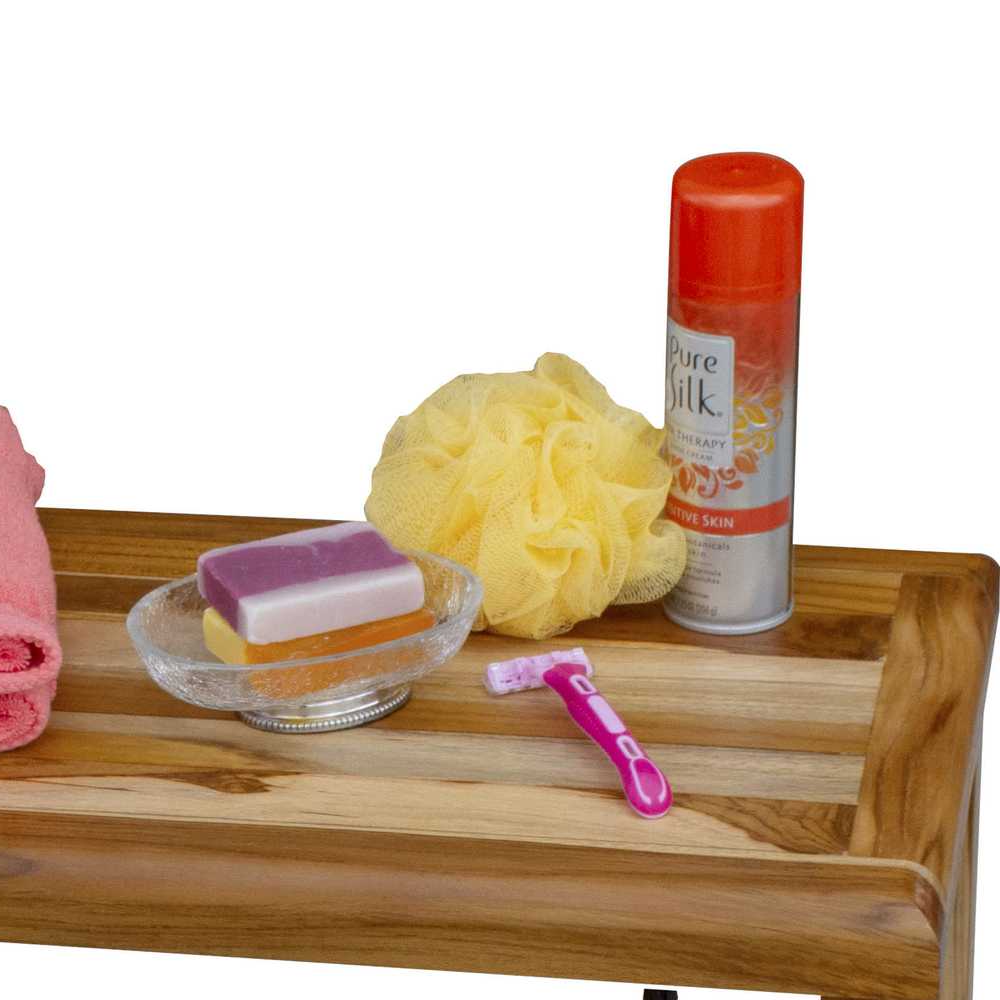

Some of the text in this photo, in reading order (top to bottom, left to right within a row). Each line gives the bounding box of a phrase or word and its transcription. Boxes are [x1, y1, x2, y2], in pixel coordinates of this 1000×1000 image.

[670, 335, 718, 374] Pure
[671, 362, 716, 417] Silk
[677, 430, 726, 449] THERAPY
[702, 513, 735, 529] SKIN
